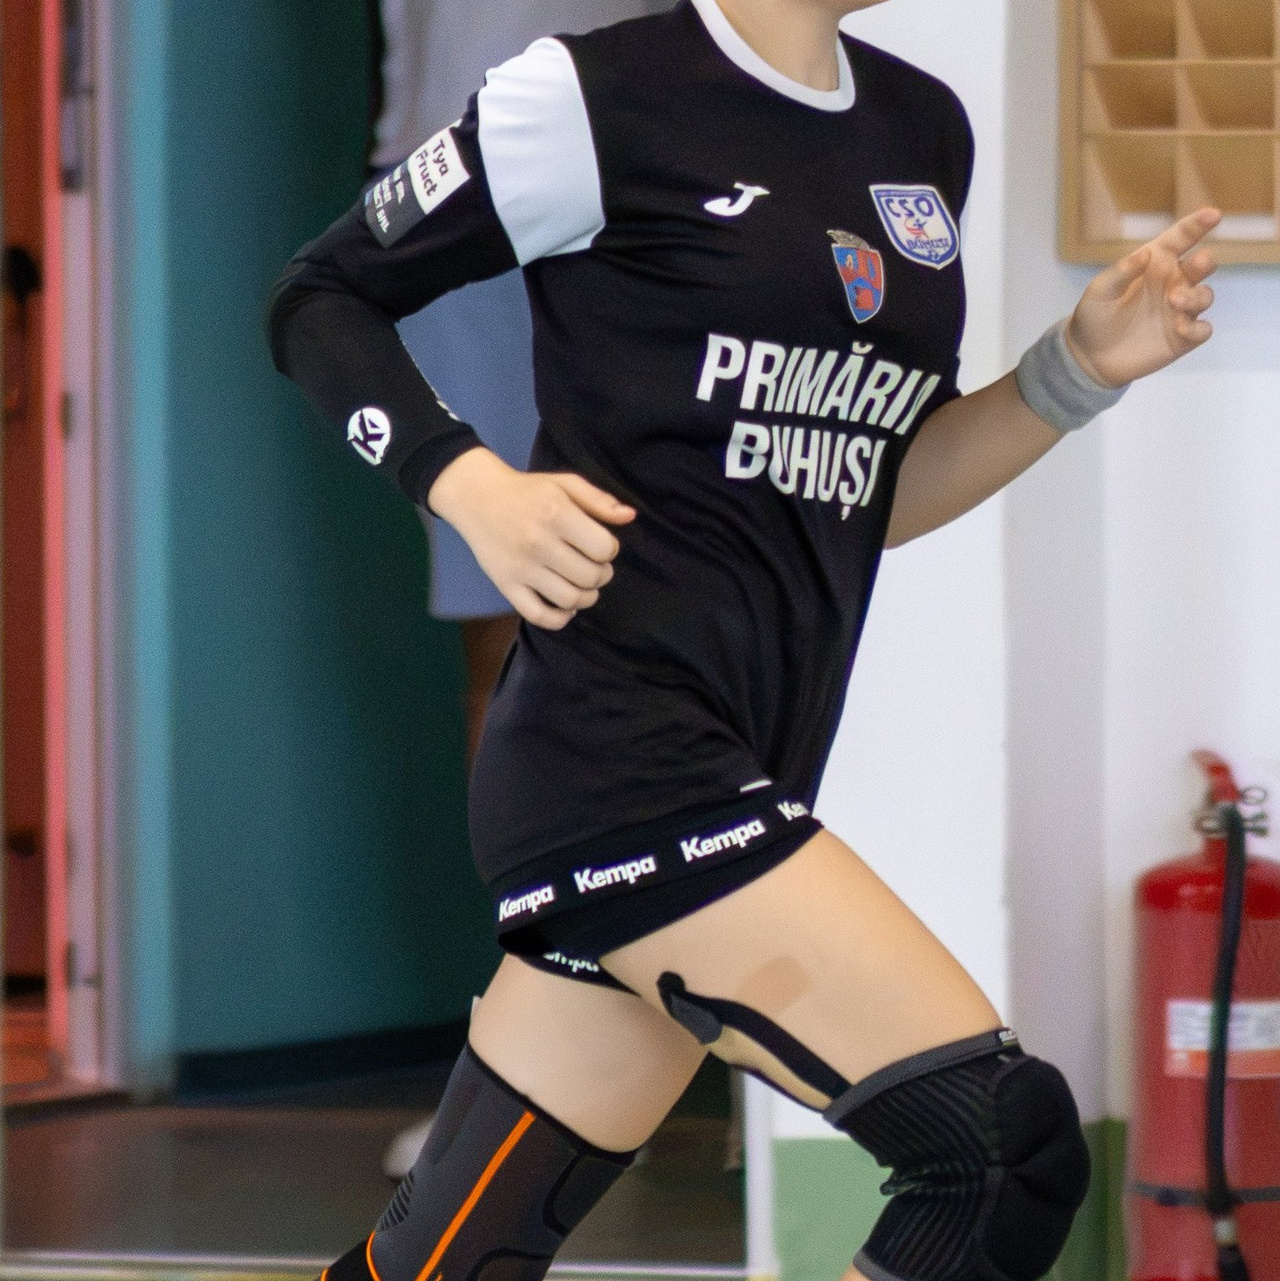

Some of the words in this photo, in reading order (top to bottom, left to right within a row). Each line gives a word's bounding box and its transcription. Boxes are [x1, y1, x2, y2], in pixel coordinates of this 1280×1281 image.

[416, 148, 438, 198] Fruct
[432, 139, 449, 177] Tya
[884, 196, 934, 218] CSO
[499, 884, 555, 922] Kempa
[573, 855, 657, 893] Kempa
[680, 819, 766, 862] Kempa
